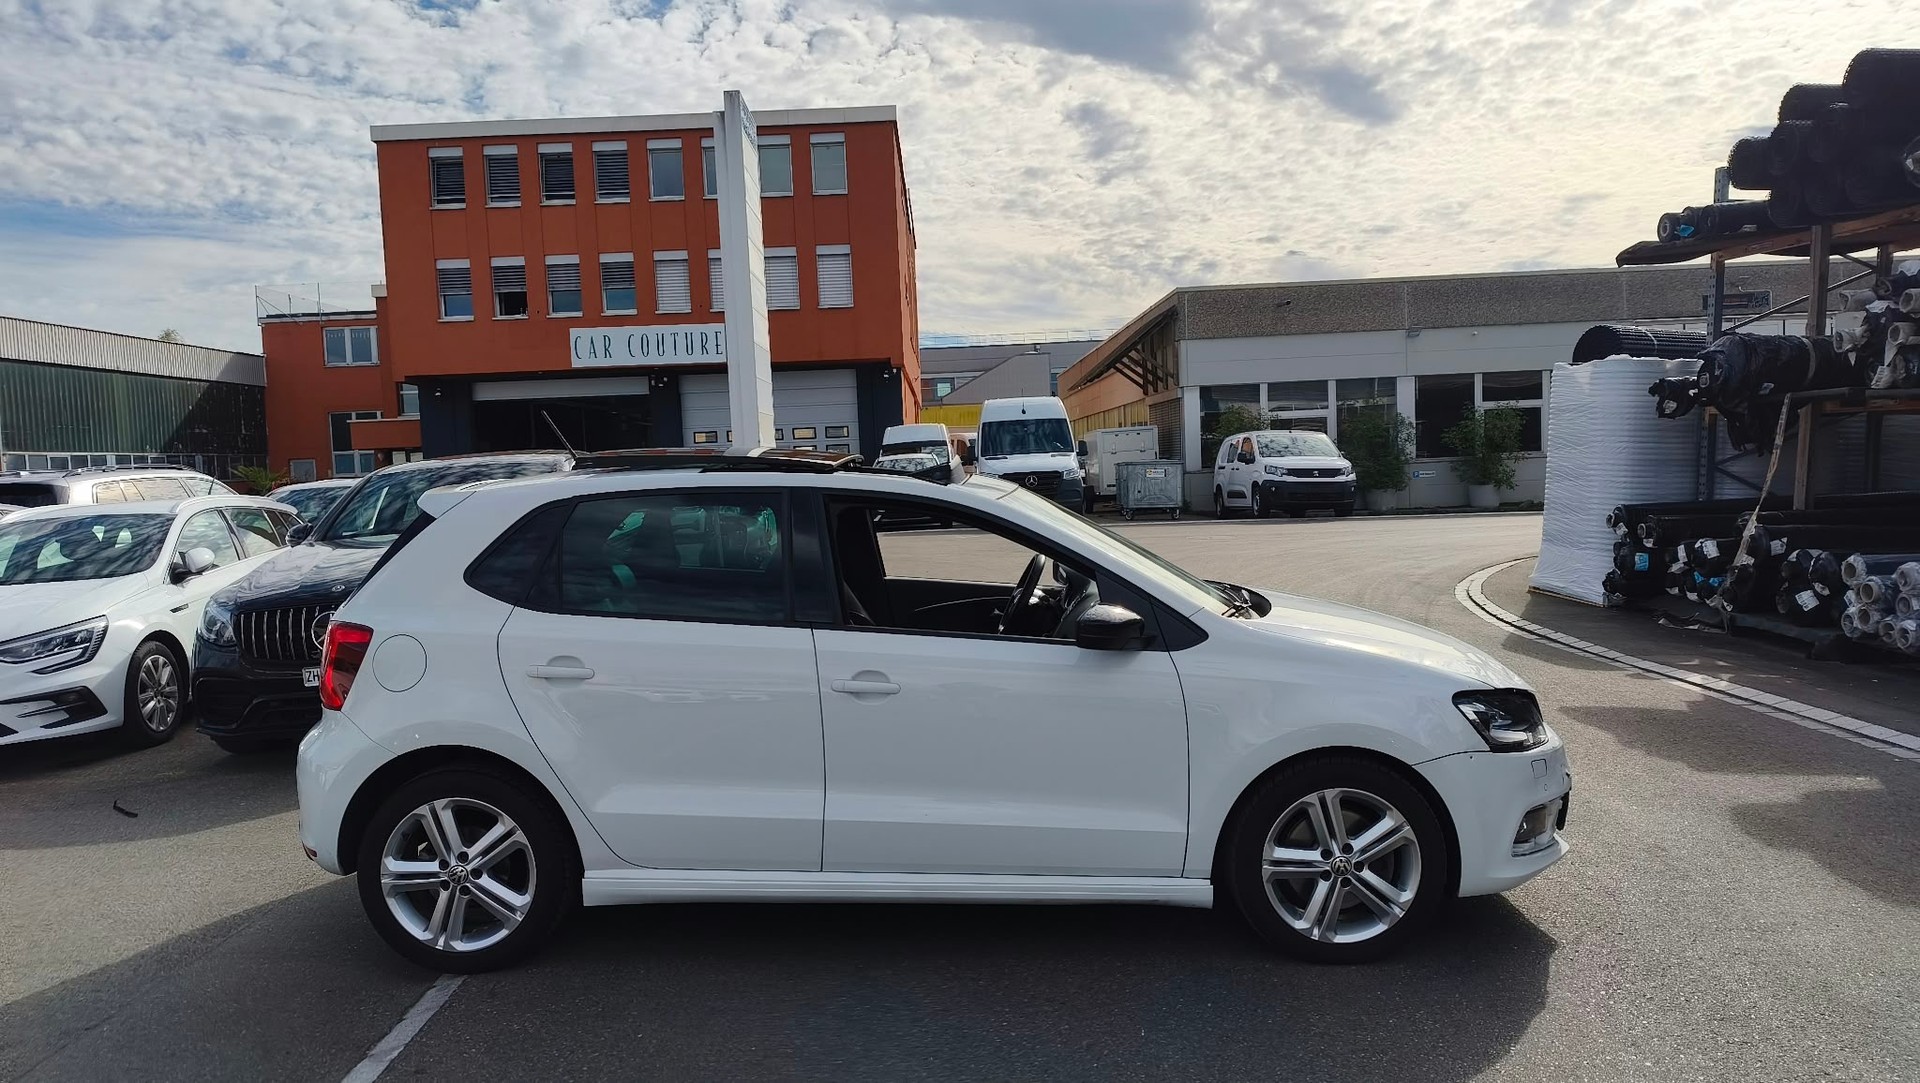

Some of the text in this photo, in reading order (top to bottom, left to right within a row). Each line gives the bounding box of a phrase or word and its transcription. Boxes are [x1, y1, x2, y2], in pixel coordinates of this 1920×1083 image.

[574, 331, 723, 359] CAR COUTURE
[306, 670, 319, 682] ZH
